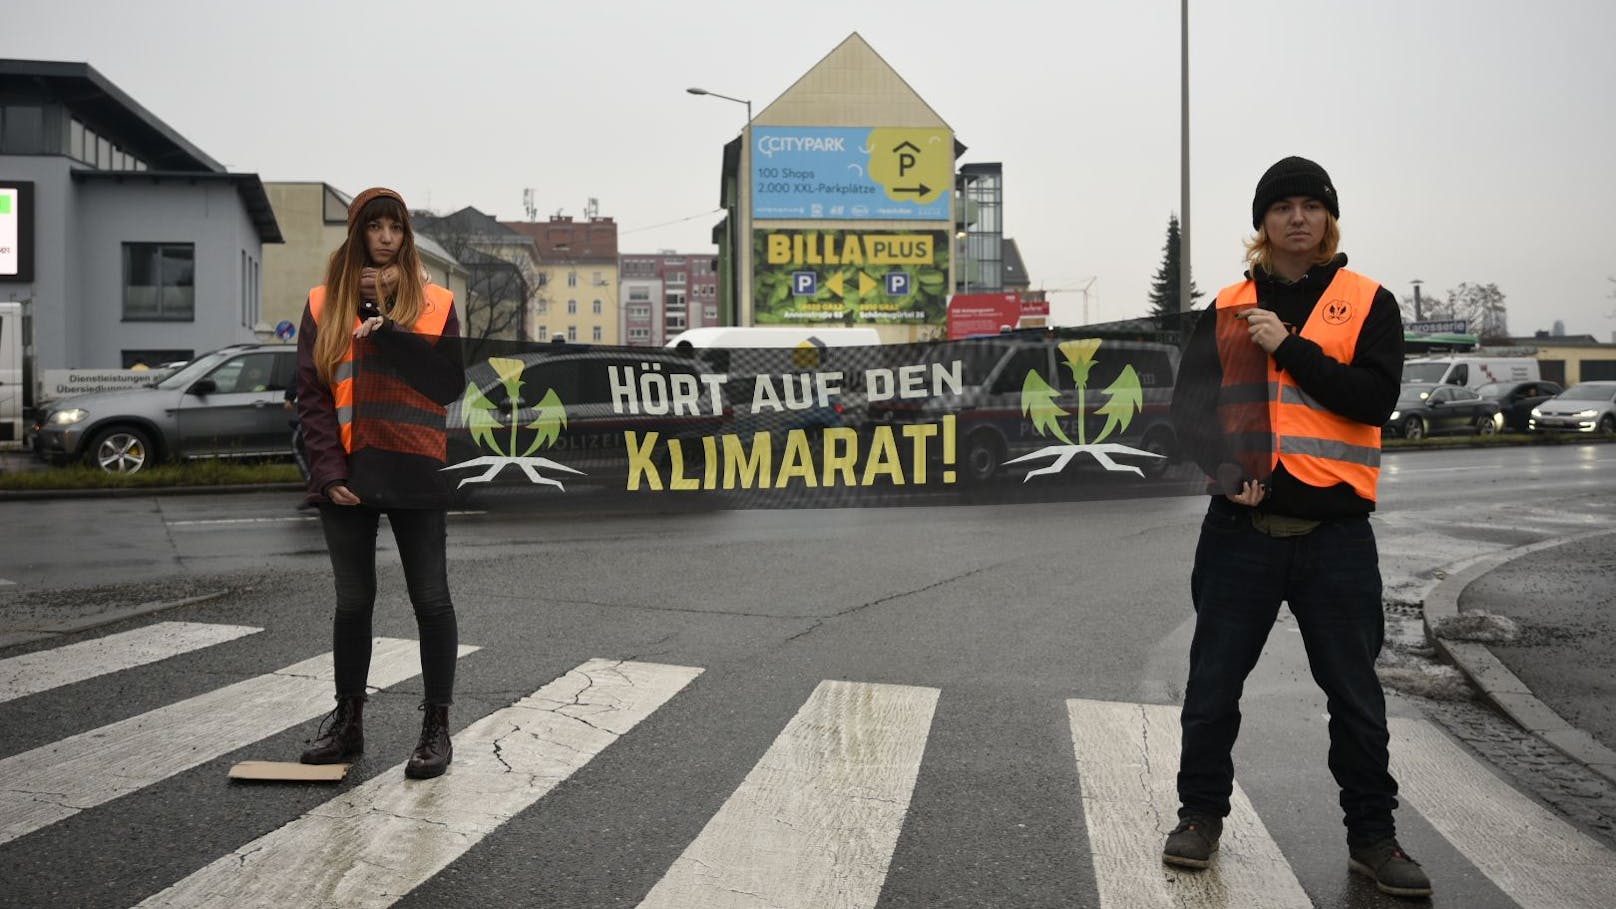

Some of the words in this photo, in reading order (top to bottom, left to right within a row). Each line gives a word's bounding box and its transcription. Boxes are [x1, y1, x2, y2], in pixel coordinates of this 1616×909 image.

[768, 136, 846, 153] CITYPARK
[758, 168, 778, 179] 100
[782, 168, 815, 180] Shops
[900, 154, 916, 178] P
[758, 183, 789, 194] 2.000
[793, 182, 876, 195] XXL-Parkplätze
[768, 234, 864, 264] BILLA
[873, 242, 927, 258] PLUS
[798, 275, 812, 293] P
[891, 275, 905, 293] P
[70, 374, 150, 383] Dienstleistungen
[608, 363, 728, 416] HÖRT
[751, 372, 844, 414] AUF
[866, 360, 963, 402] DEN
[625, 415, 957, 491] KLIMARAT!
